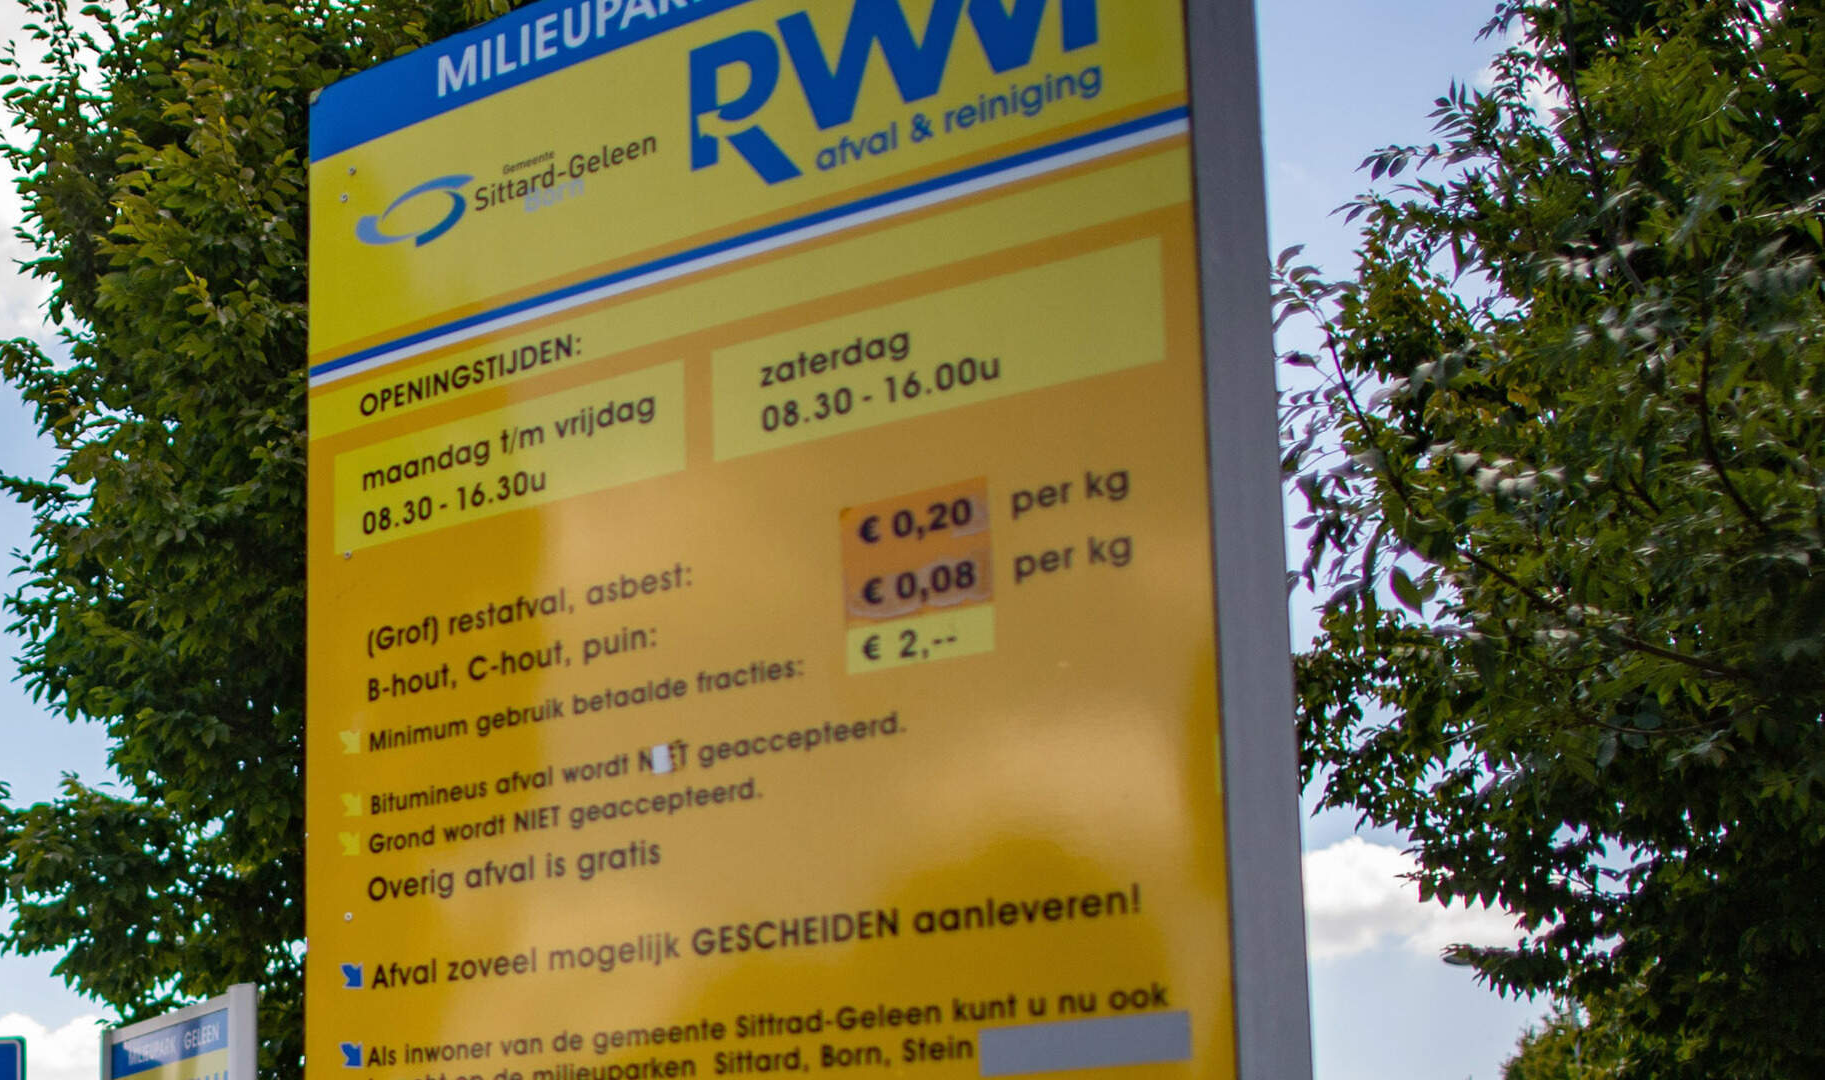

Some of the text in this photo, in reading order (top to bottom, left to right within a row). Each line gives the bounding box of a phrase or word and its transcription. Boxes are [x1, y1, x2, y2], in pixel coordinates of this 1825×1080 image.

[437, 0, 703, 98] MILIEUPA
[815, 64, 1103, 172] afval & reiniging
[475, 135, 658, 212] Sittard-Geleen
[502, 150, 555, 175] Gemeente
[359, 333, 583, 418] OPENINGSTIJDEN:
[760, 331, 910, 388] zaterdag
[761, 387, 853, 433] 08.30
[885, 357, 1001, 404] 16.00u
[362, 394, 657, 492] maandag t/m vrijdag
[362, 496, 433, 537] 08.30
[457, 470, 548, 512] 16.30u
[858, 498, 973, 545] € 0,20
[1011, 470, 1130, 520] per kg
[862, 560, 976, 606] € 0,08
[1014, 535, 1133, 585] per kg
[367, 562, 693, 660] (Grof) restafval, asbest:
[862, 636, 881, 662] €
[367, 626, 658, 702] B-hout, C-hout, puin:
[368, 658, 806, 753] Minimum gebruik betaalde fracties:
[371, 711, 908, 816] Bitumineus afval wordt NET geaccepteerd.
[369, 778, 764, 854] Grond wordt NIET geaccepteerd.
[368, 840, 661, 901] Overig afval is gratis
[371, 883, 1142, 990] Afval zoveel mogelijk GESCHEIDEN aanleveren!
[367, 981, 1170, 1068] Als inwoner van de gemeente Sittrad-Geleen kunt u nu ook
[714, 1045, 810, 1076] Sittard,
[820, 1042, 891, 1070] Born,
[902, 1035, 975, 1063] Stein
